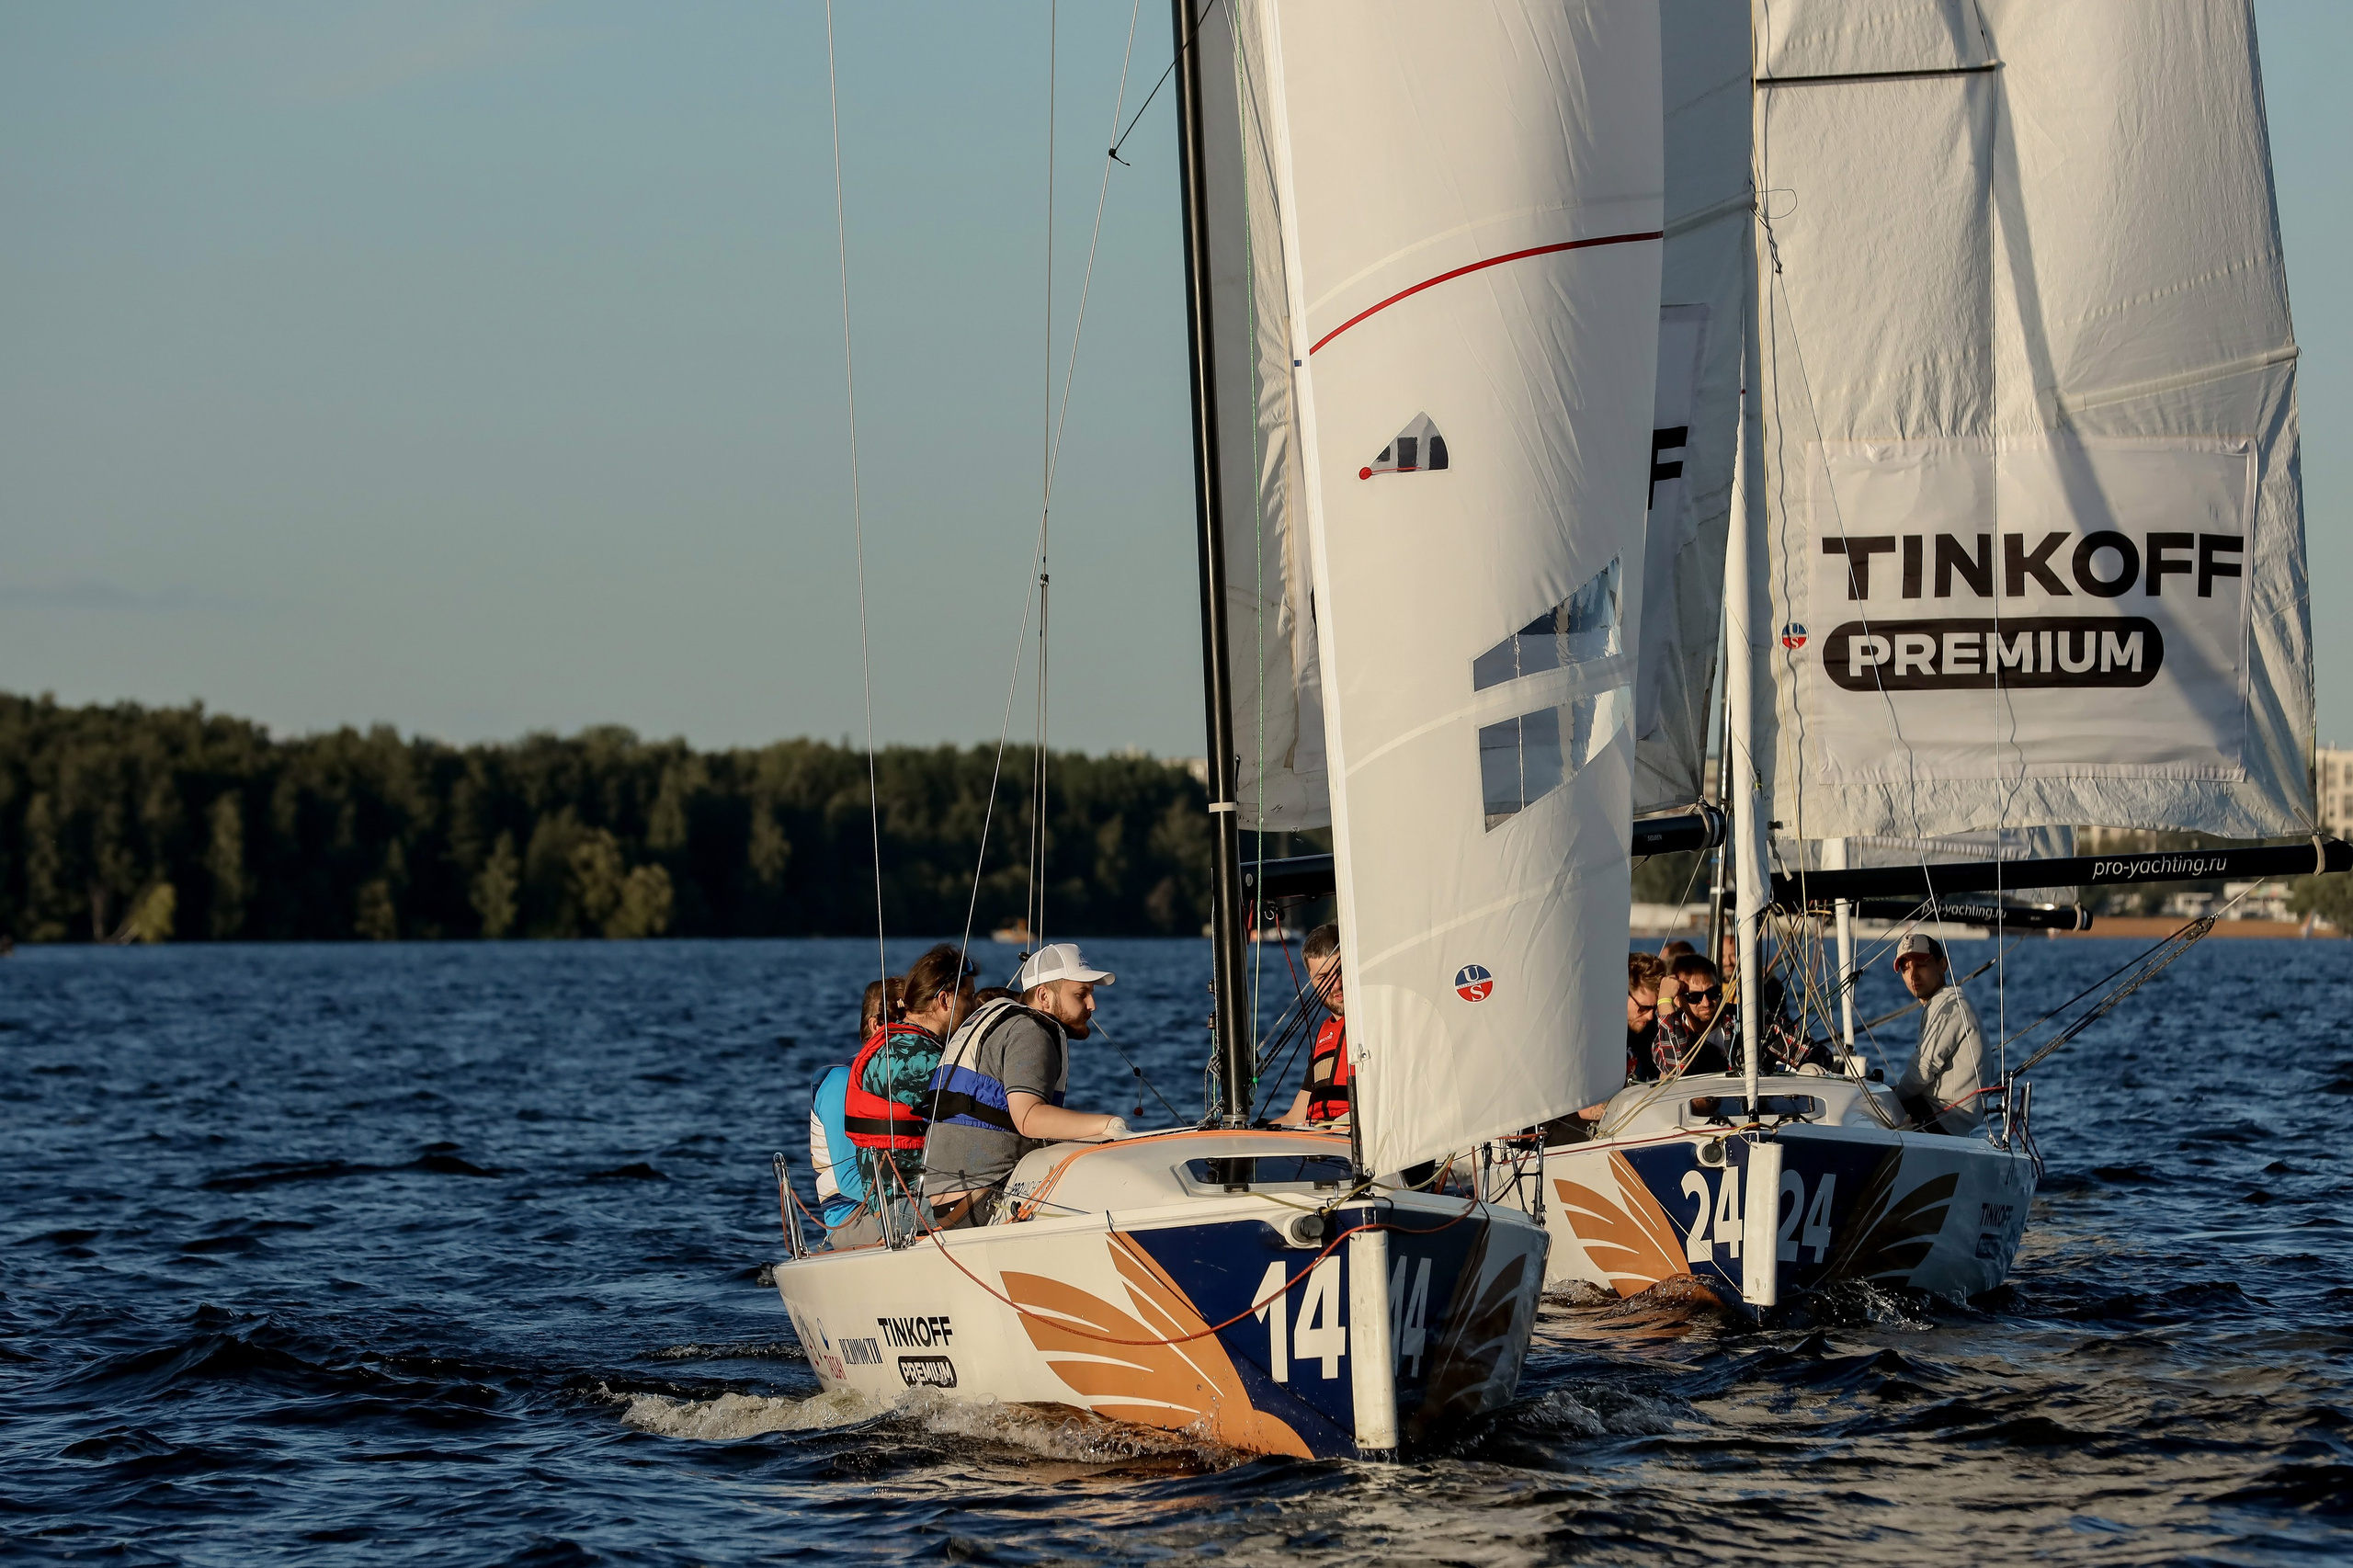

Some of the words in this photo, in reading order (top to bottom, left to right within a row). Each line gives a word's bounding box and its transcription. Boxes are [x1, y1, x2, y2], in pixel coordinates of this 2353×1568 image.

[1823, 530, 2244, 601] TINKOFF
[1848, 631, 2144, 677] PREMIUM
[2092, 856, 2227, 880] pro-yachting.ru
[1921, 903, 2007, 921] po-yachting.ru
[1680, 1165, 1743, 1264] 24
[1777, 1169, 1836, 1264] 24
[1980, 1202, 2014, 1229] TINKOFF
[877, 1316, 953, 1347] TINKOFF
[1251, 1255, 1346, 1383] 14
[1389, 1256, 1432, 1378] 14
[900, 1361, 954, 1382] PREMIUM
